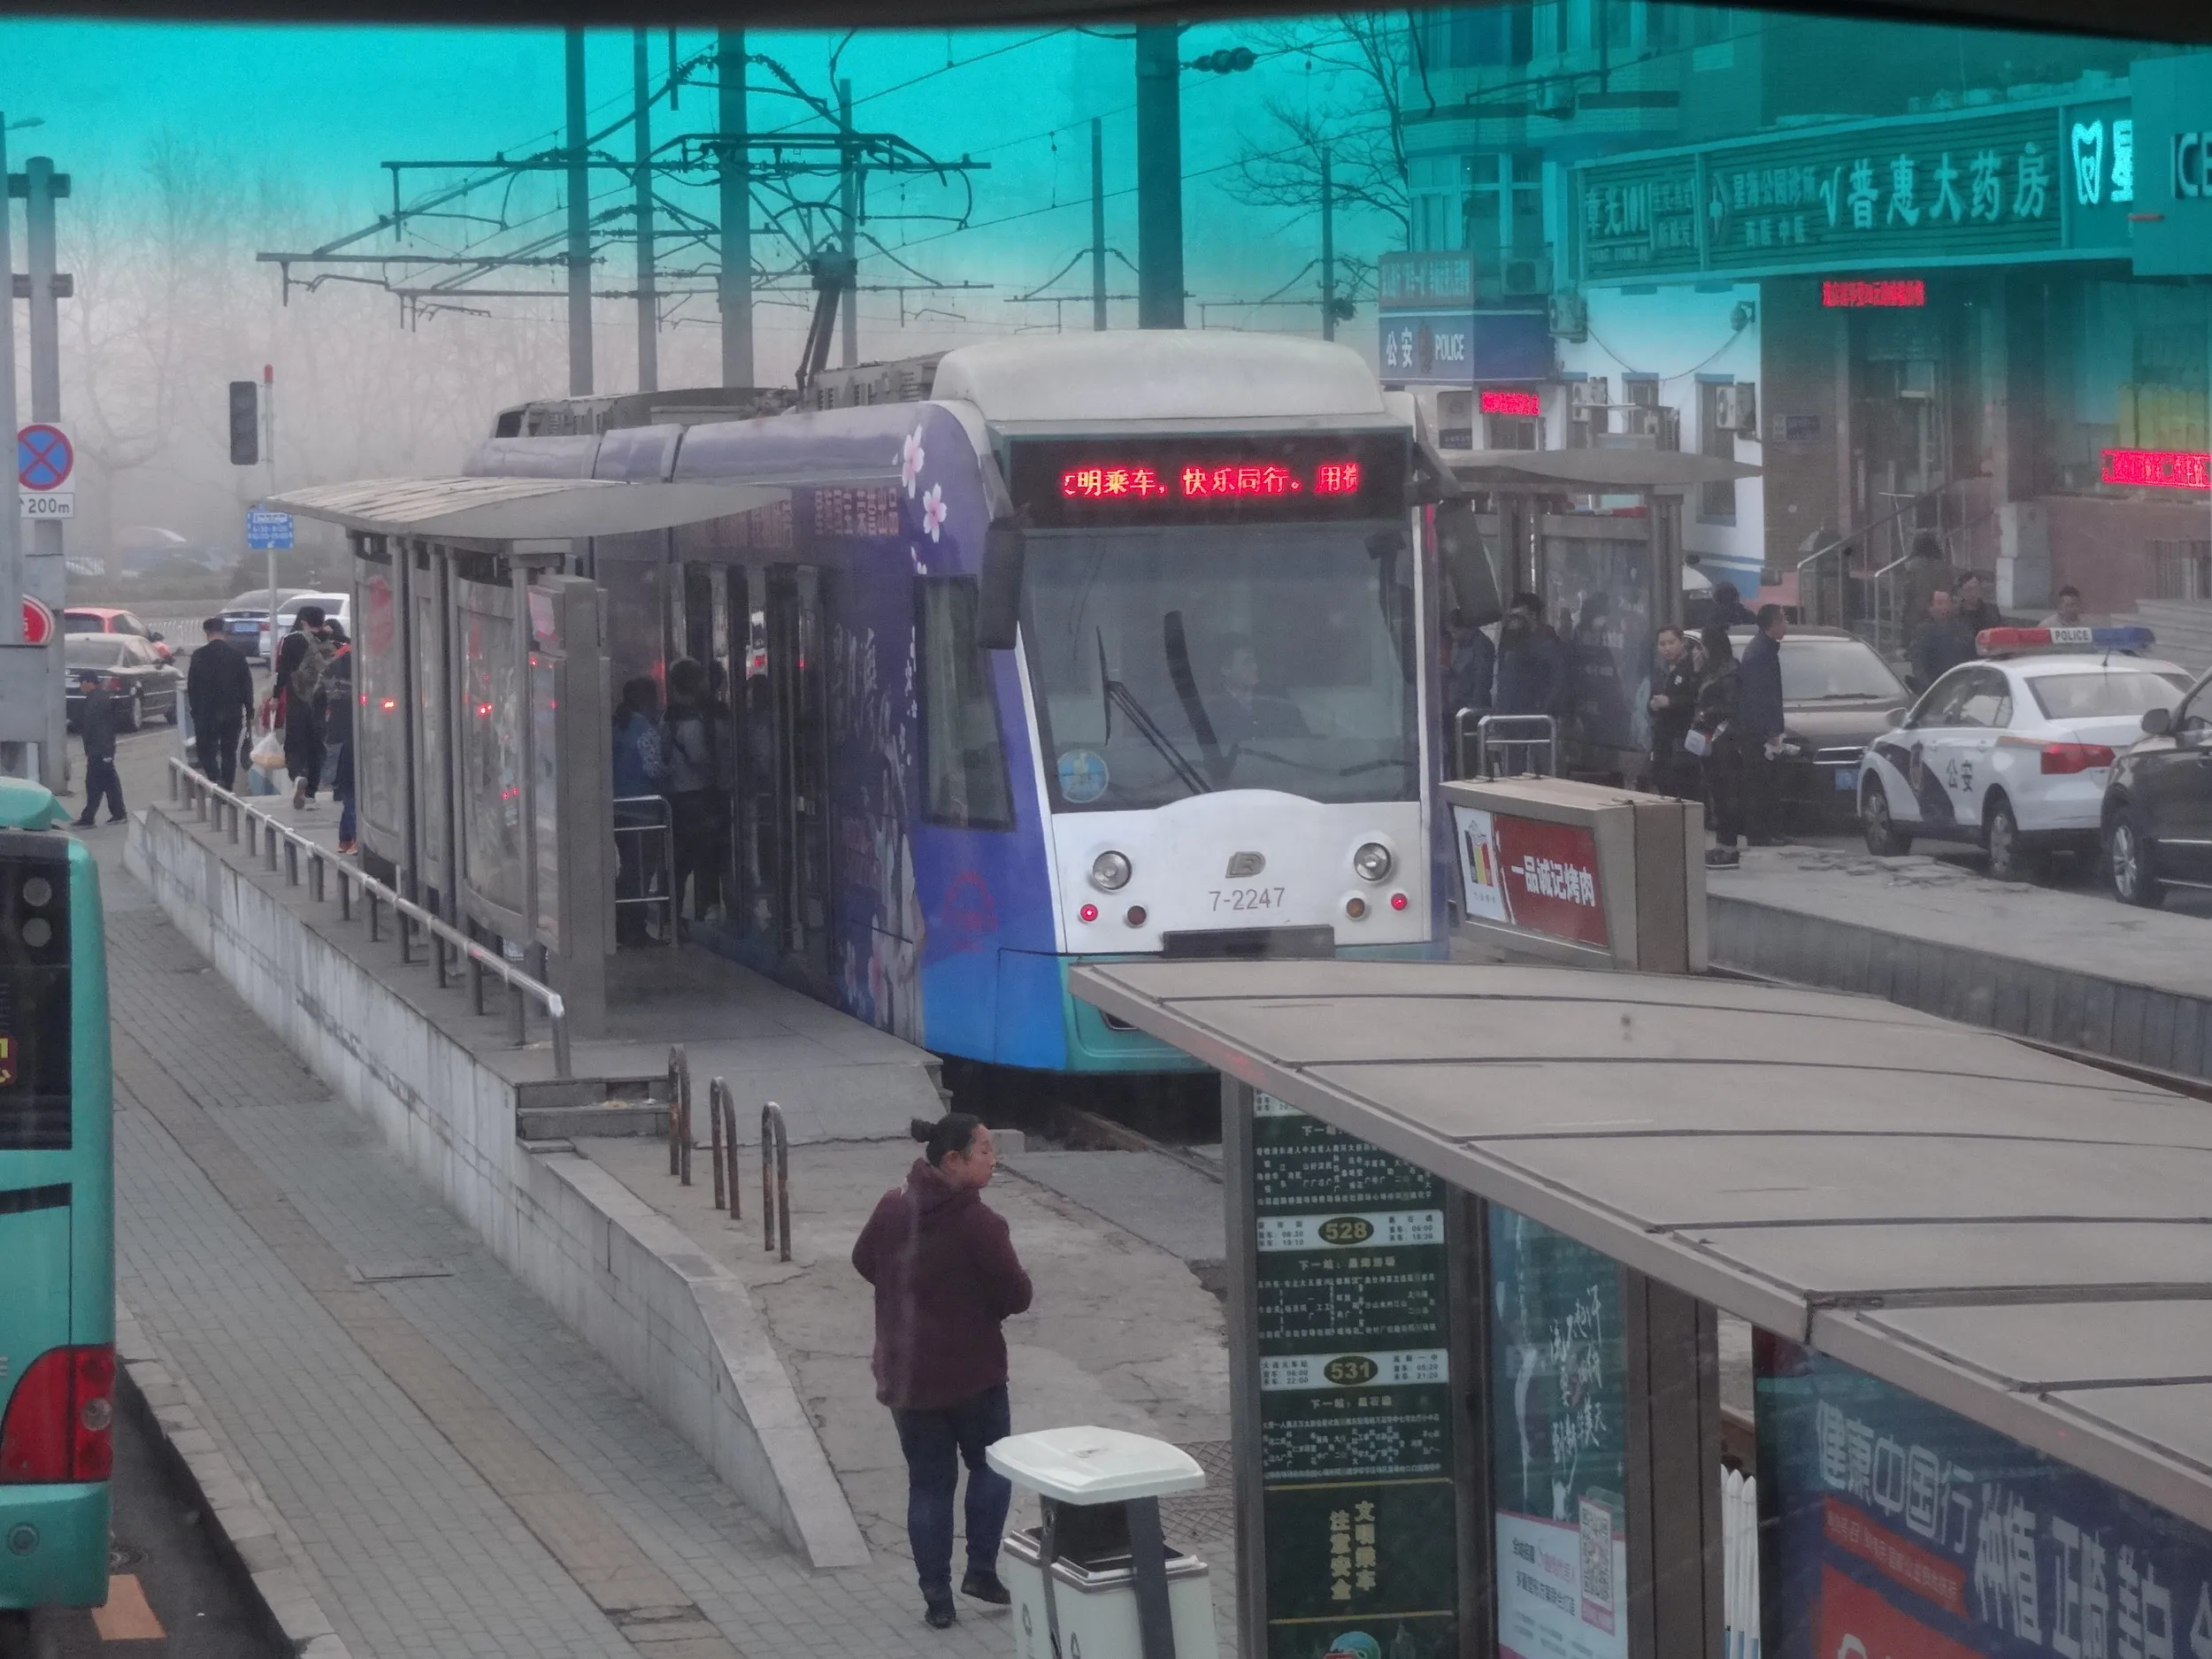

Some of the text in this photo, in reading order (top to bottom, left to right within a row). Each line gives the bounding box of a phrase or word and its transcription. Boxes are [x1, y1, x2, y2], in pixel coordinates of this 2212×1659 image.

[1847, 143, 2050, 229] 普惠大药房
[1386, 326, 1465, 368] 公安 POLICE
[28, 498, 69, 513] 200m
[2055, 629, 2089, 641] POLICE
[1209, 887, 1286, 911] 7-2247
[1326, 1222, 1368, 1240] 528
[1331, 1362, 1371, 1382] 531
[1816, 1399, 1975, 1555] 健康中国行
